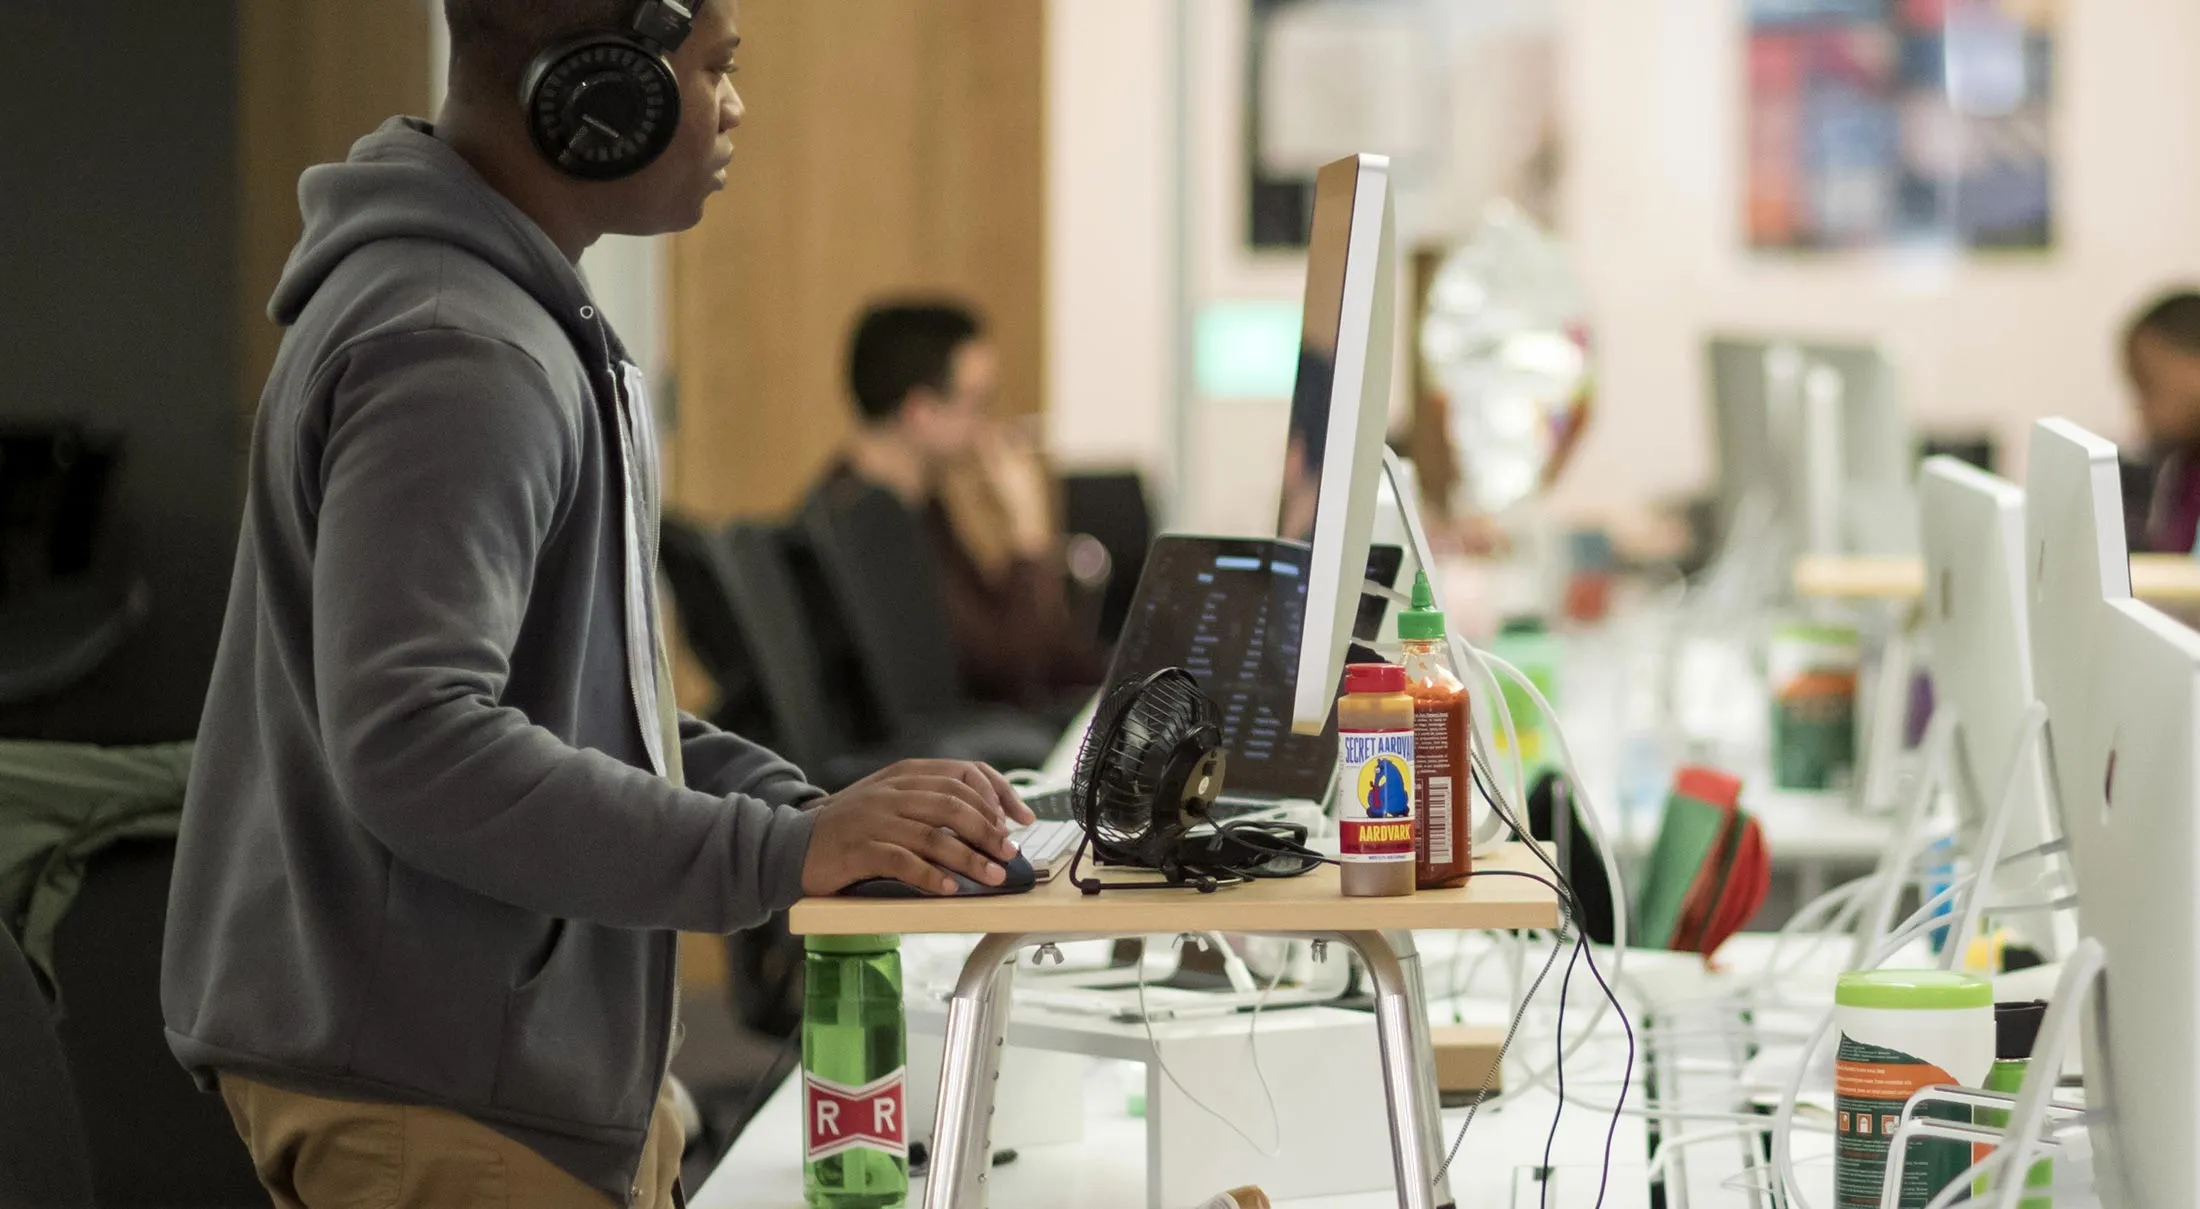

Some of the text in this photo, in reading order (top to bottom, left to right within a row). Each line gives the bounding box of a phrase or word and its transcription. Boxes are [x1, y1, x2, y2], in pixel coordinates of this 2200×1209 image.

[1345, 737, 1376, 763] SECRET
[1359, 824, 1411, 842] AARDVARK
[817, 1097, 896, 1135] R R
